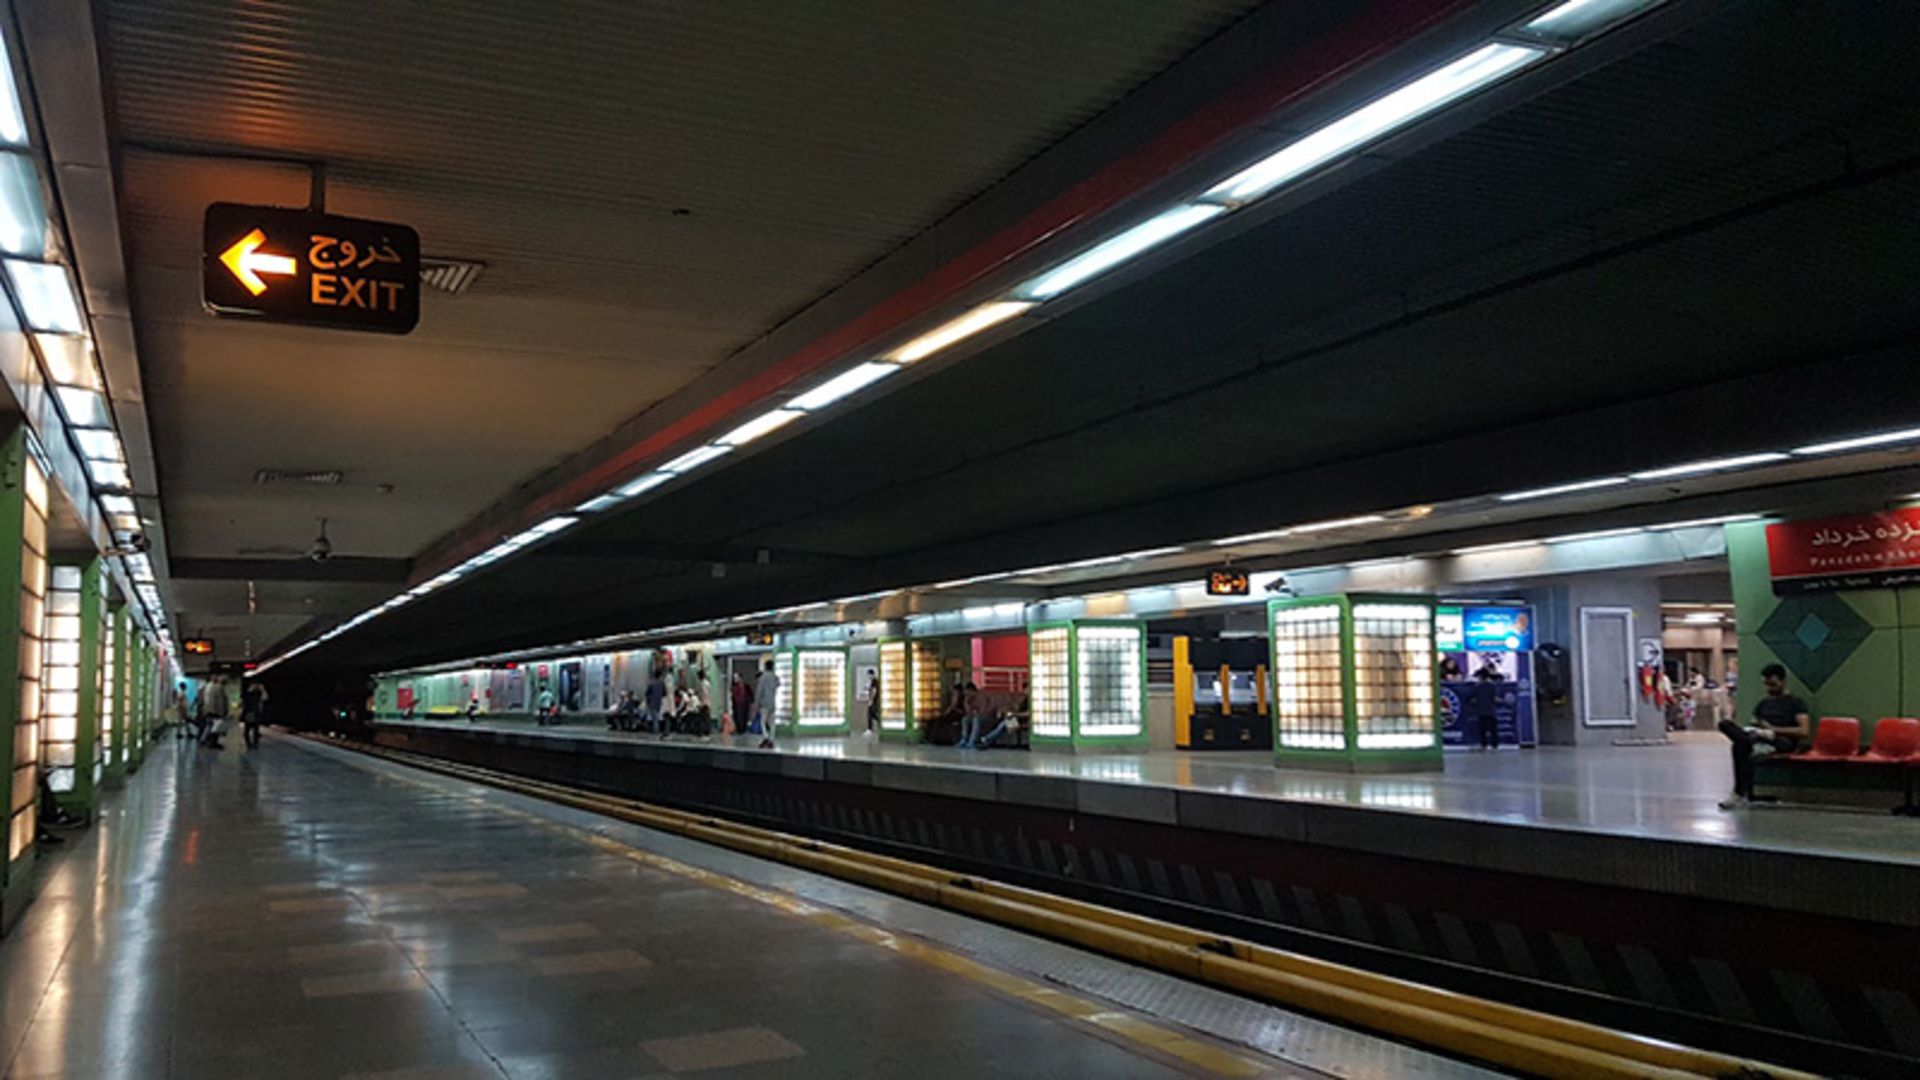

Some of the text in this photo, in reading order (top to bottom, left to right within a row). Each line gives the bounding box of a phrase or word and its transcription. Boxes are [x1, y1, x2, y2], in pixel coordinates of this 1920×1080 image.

[310, 235, 401, 269] خروج
[312, 273, 404, 310] EXIT
[1812, 523, 1920, 547] زده خرداد
